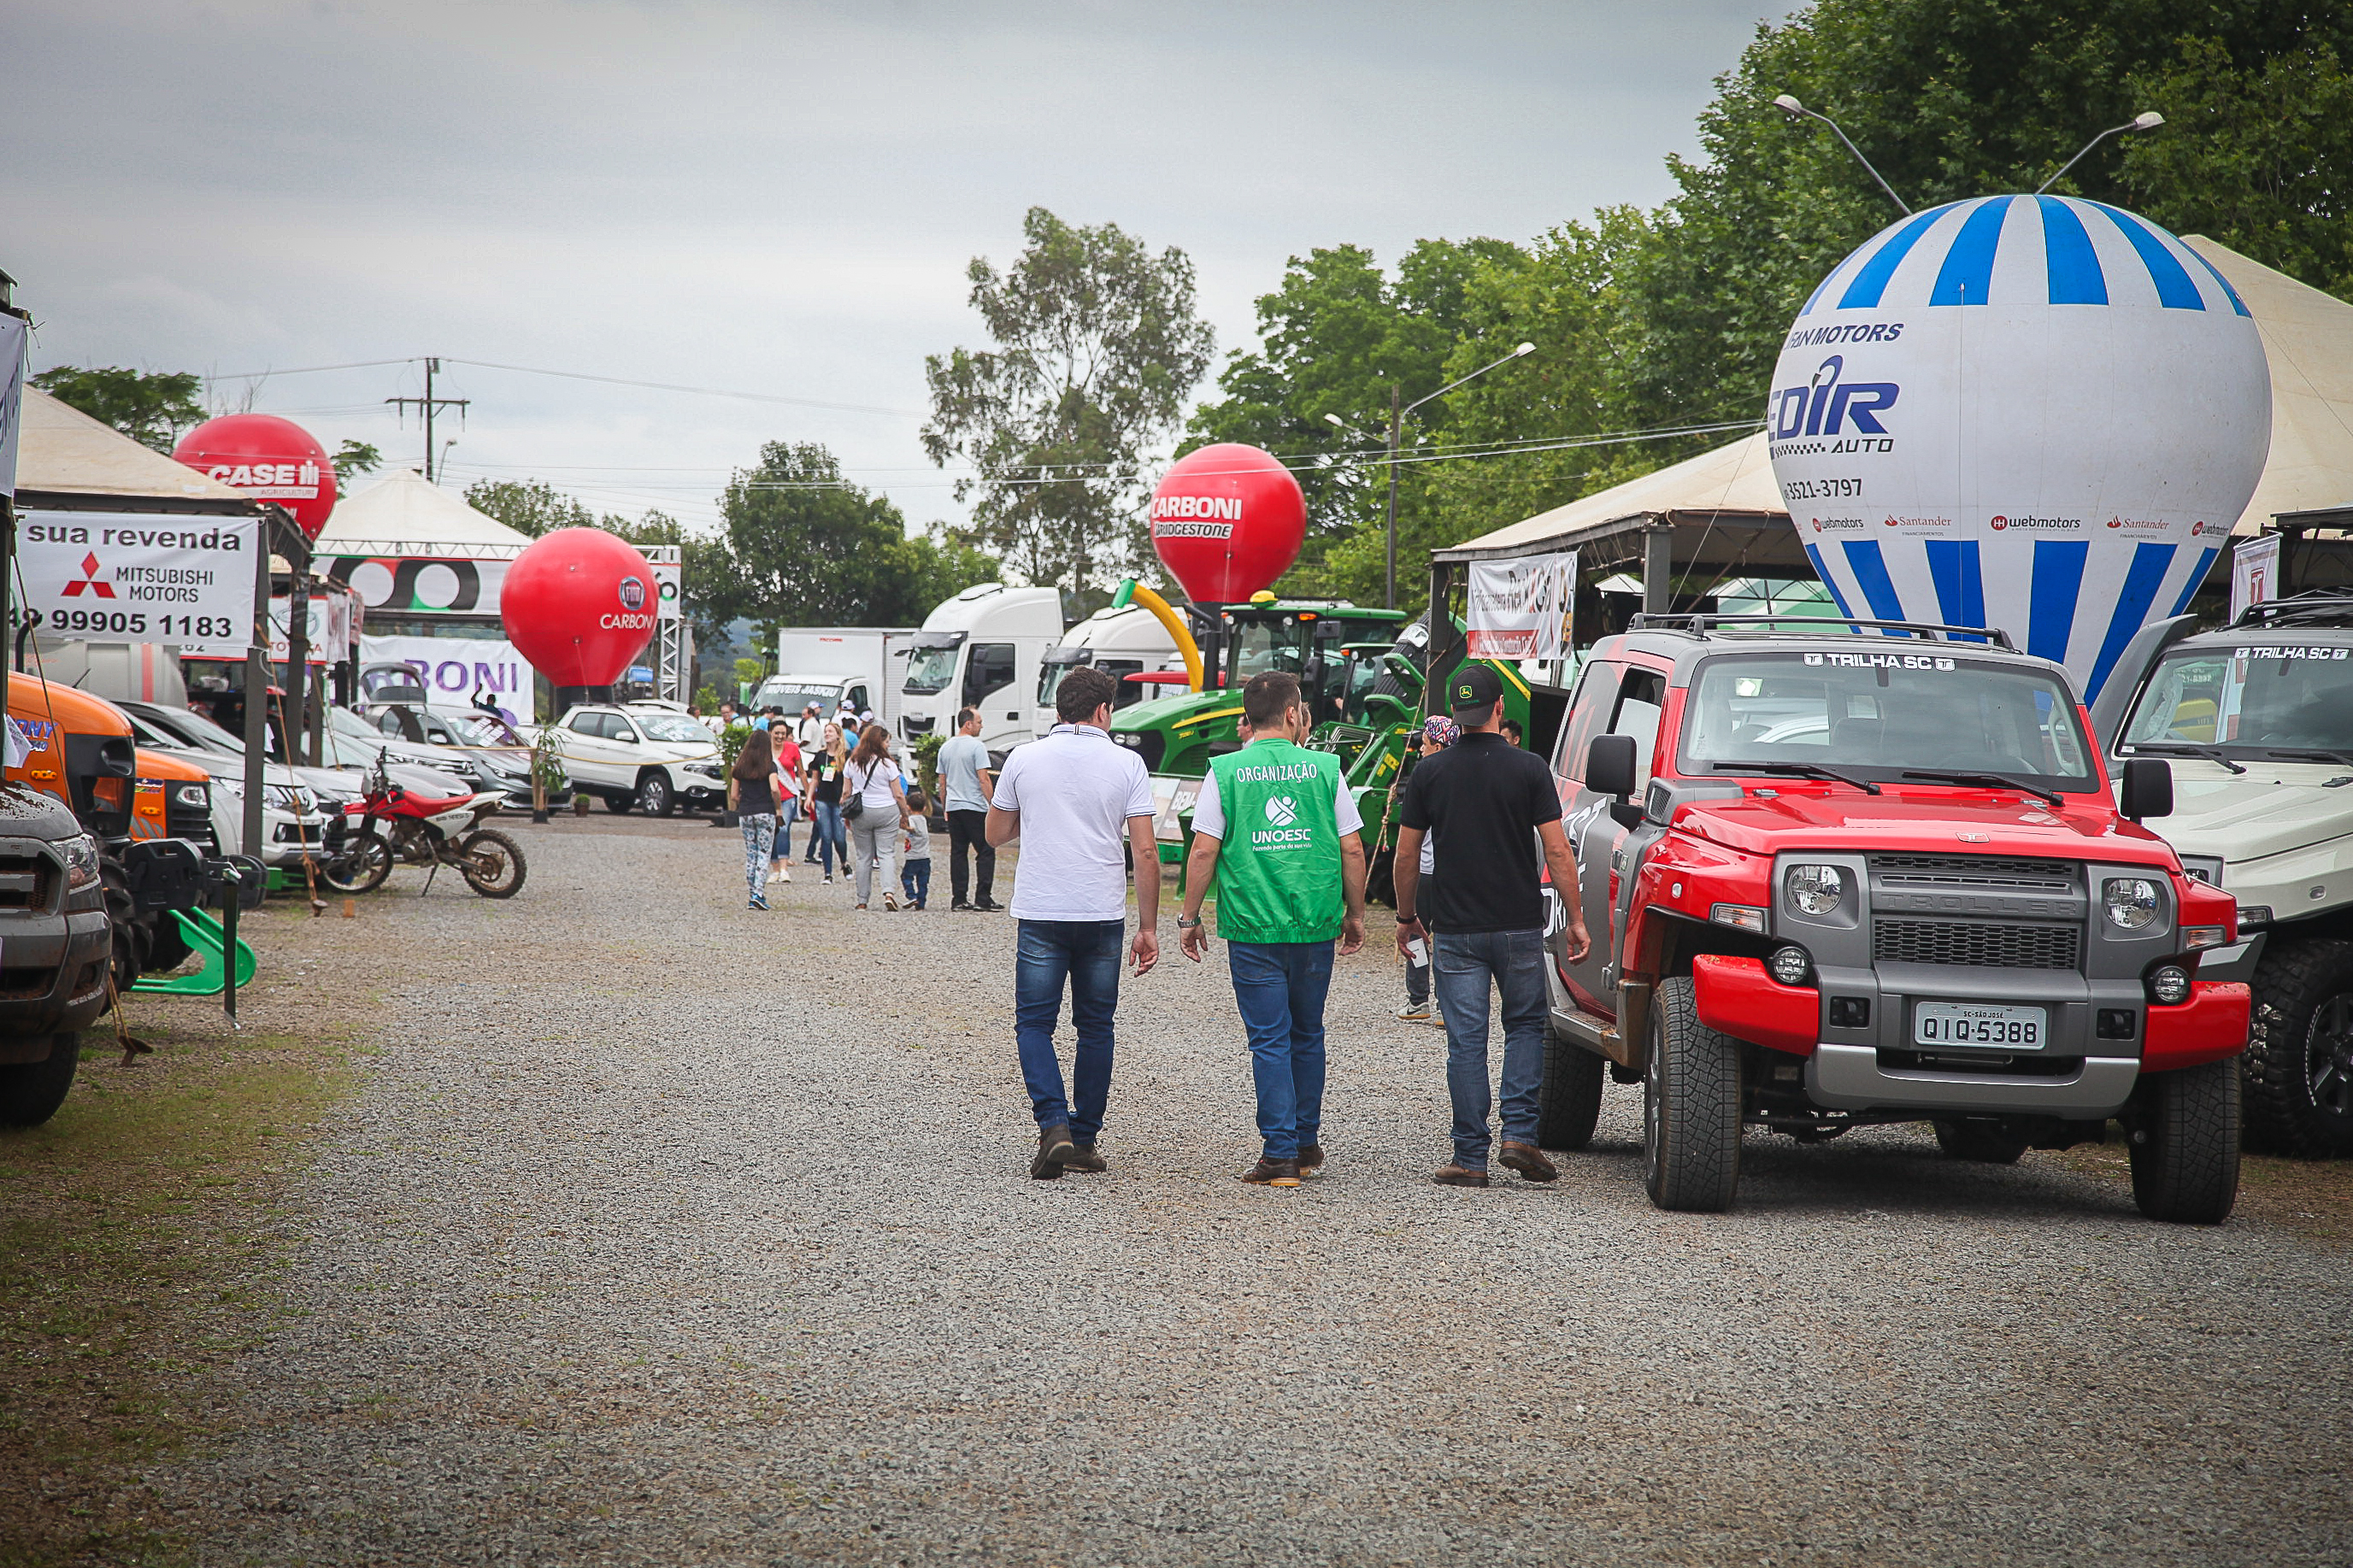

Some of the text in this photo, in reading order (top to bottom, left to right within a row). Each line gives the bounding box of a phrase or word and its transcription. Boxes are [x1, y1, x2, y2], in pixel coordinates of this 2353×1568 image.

[1812, 324, 1904, 345] MOTORS
[1831, 439, 1894, 453] AUTO
[209, 464, 296, 486] CASE
[1787, 479, 1862, 500] 3521-3797
[1151, 496, 1243, 520] CARBONI
[1899, 515, 1951, 526] Santander
[2009, 514, 2081, 528] webmotors
[2122, 518, 2170, 530] Santander
[27, 525, 241, 551] sua revenda
[1156, 522, 1232, 538] BRIDGESTONE
[115, 567, 214, 586] MITSUBISHI
[129, 585, 199, 602] MOTORS
[51, 609, 146, 634] 99905
[159, 614, 232, 637] 1183
[1827, 653, 1901, 668] TRILHA
[1903, 655, 1932, 670] SC
[2252, 647, 2306, 660] TRILHA
[2308, 648, 2332, 660] SC
[1236, 760, 1318, 784] ORGANIZAÇÃO
[1252, 828, 1312, 844] UNOESC
[1881, 894, 2076, 915] TROLLER
